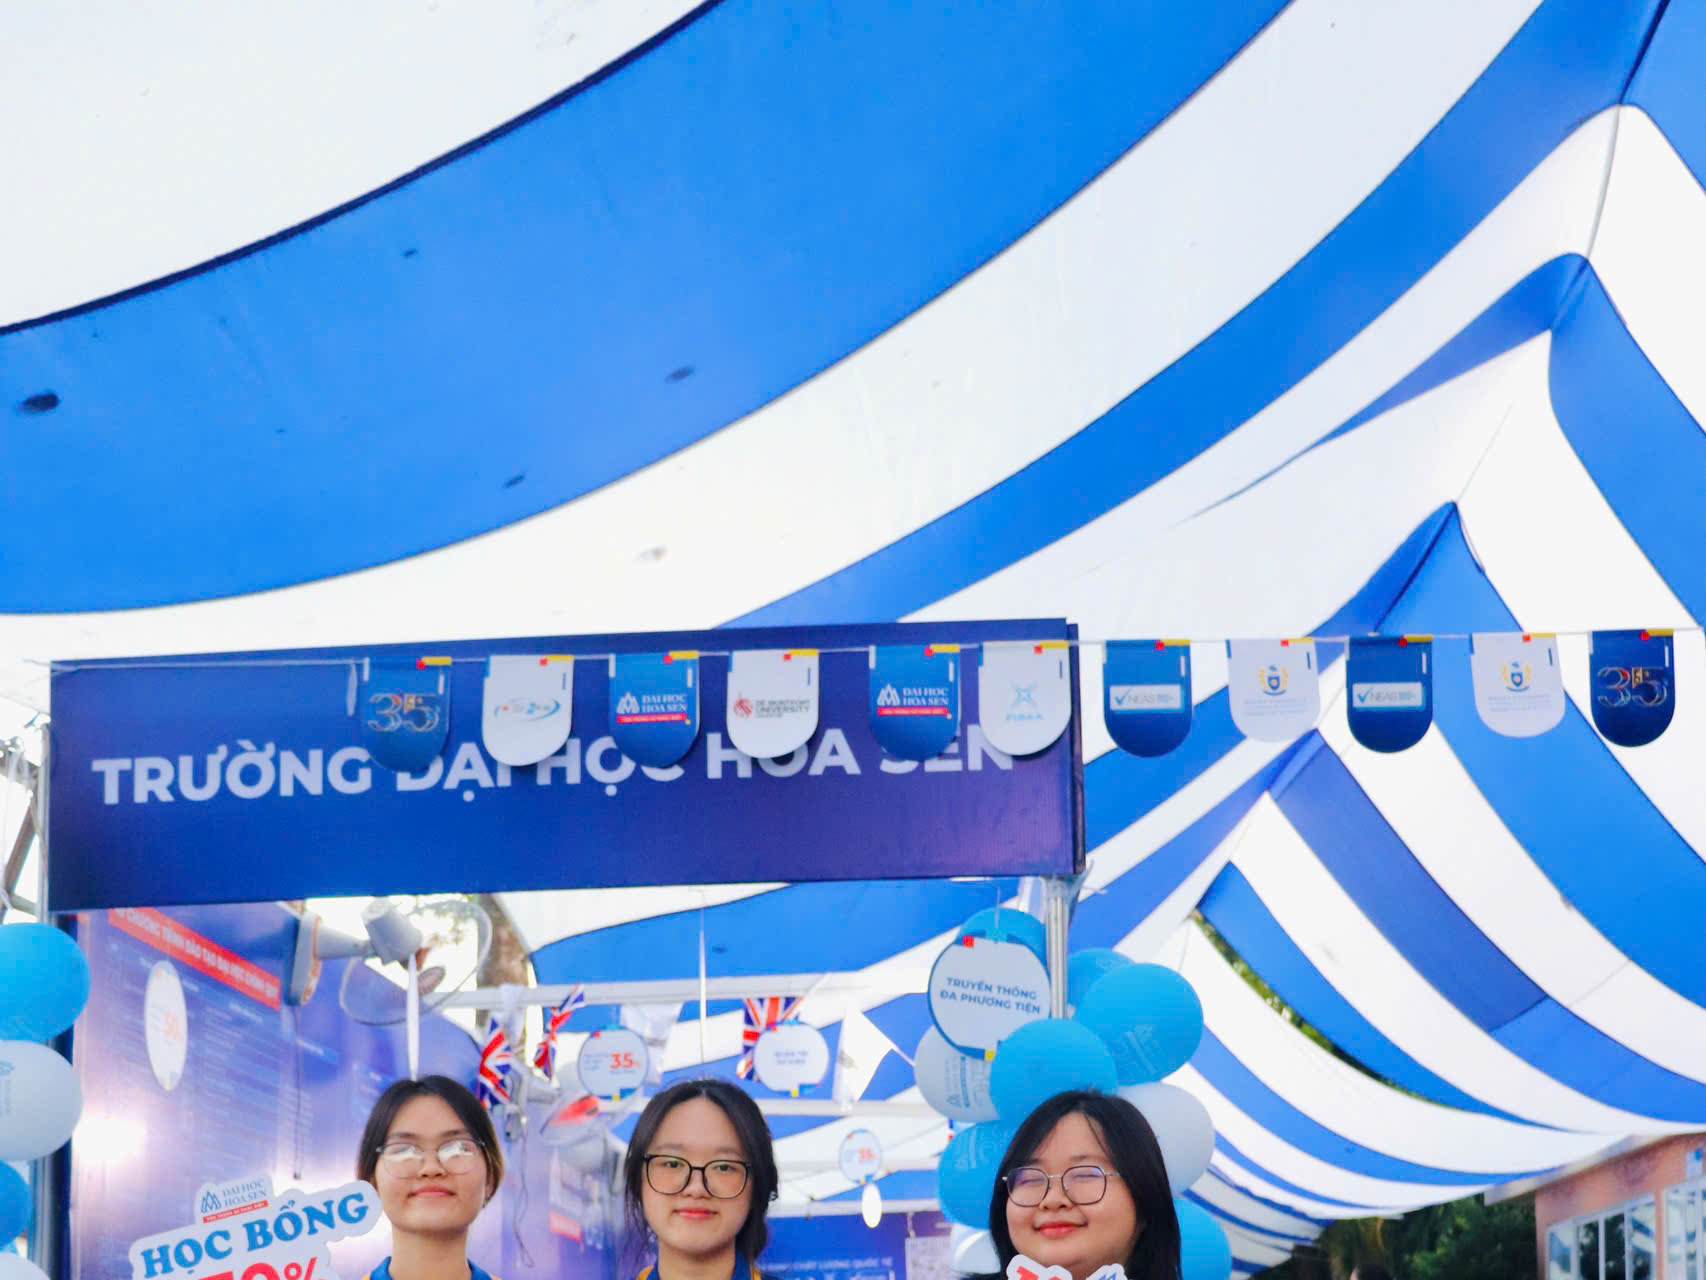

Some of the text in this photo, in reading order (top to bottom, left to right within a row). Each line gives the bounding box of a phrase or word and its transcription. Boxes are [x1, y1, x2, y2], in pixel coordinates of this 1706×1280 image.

[368, 693, 440, 732] 35
[91, 738, 372, 805] TRƯỜNG
[960, 993, 1012, 1010] PHƯƠNG
[1015, 1001, 1041, 1015] TIỆN
[996, 984, 1038, 1001] THÔNG
[609, 1052, 633, 1069] 35
[140, 1192, 370, 1279] HỌC BỔNG
